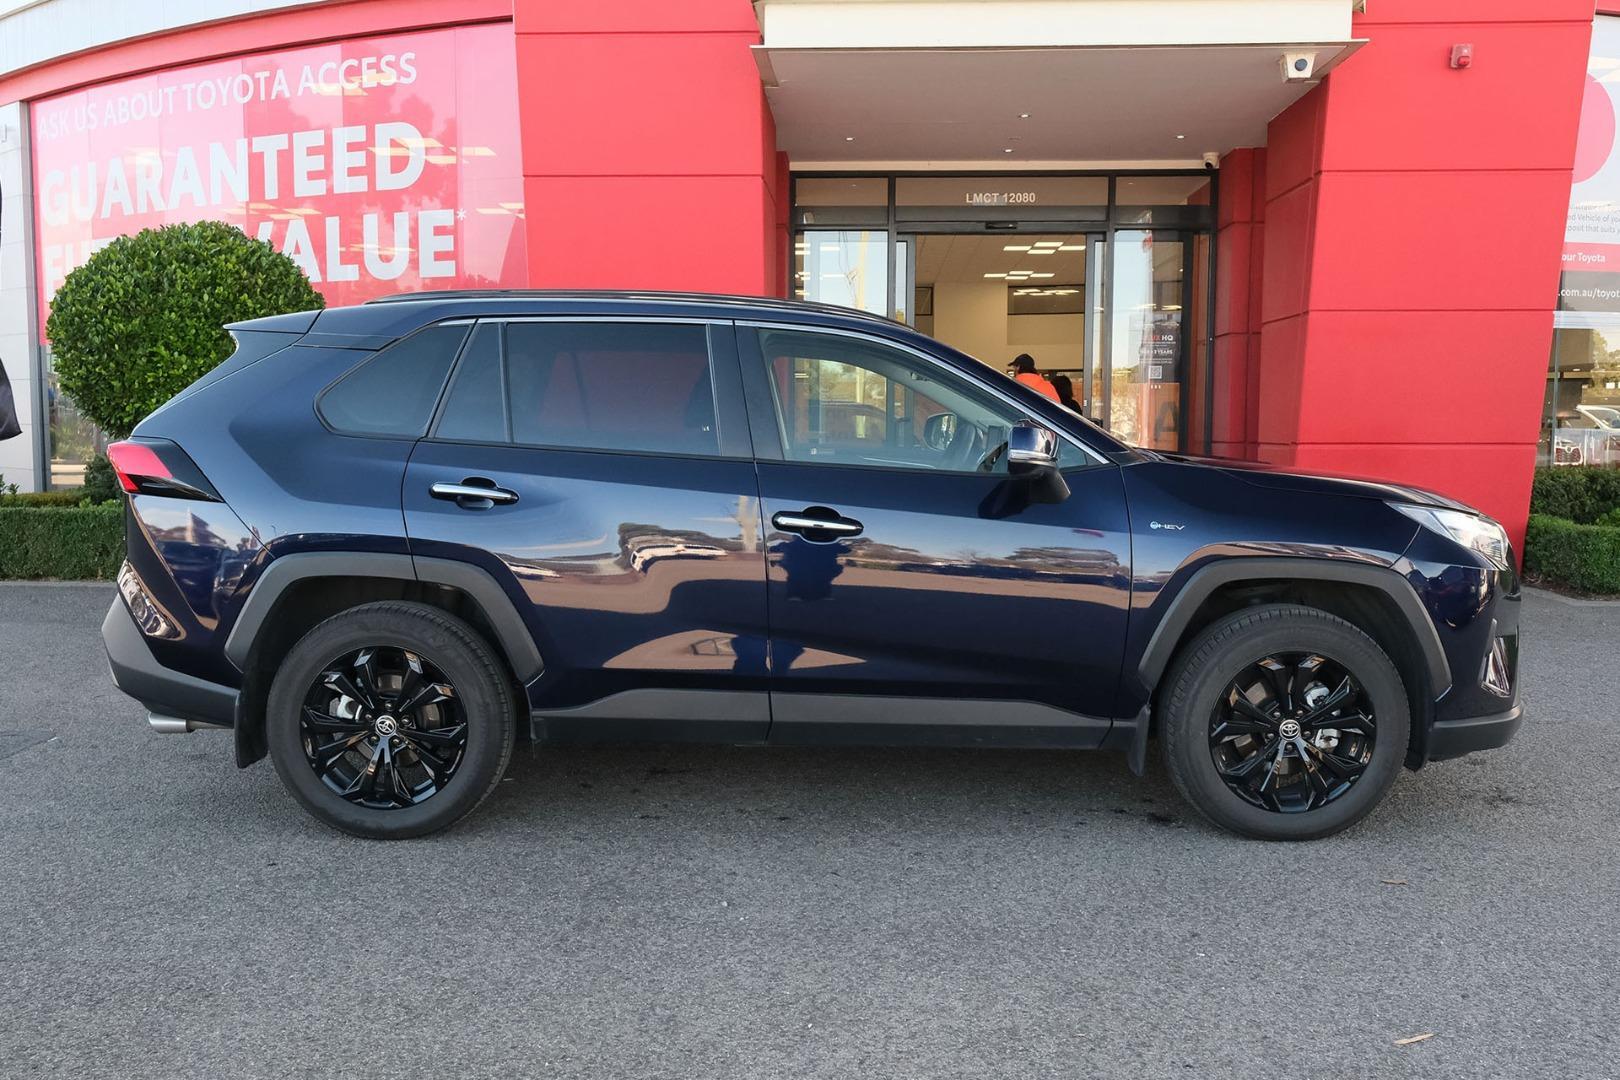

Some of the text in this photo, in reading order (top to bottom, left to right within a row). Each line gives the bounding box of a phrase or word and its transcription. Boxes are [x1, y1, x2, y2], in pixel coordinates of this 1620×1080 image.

[38, 52, 417, 143] ASK US ABOUT TOYOTA ACCESS
[42, 121, 427, 227] GUARANTEED
[965, 192, 1036, 204] LMCT 12080
[1577, 252, 1606, 264] Toyota
